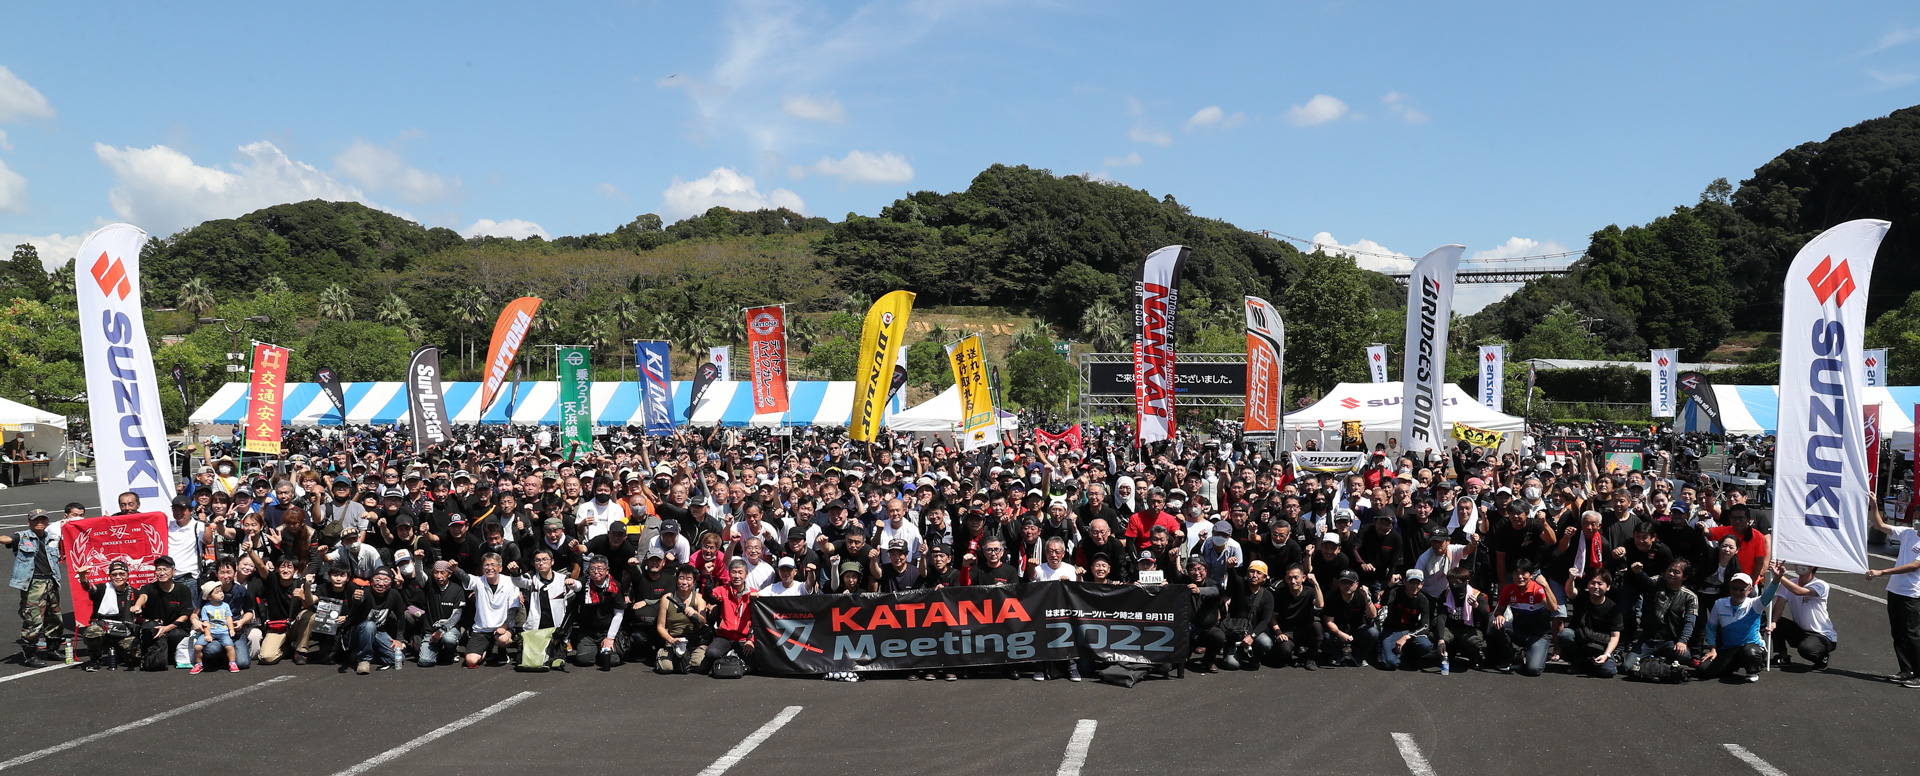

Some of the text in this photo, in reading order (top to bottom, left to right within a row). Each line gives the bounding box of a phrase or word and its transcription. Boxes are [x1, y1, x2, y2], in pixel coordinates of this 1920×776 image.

[1135, 281, 1143, 297] FOR
[1166, 288, 1178, 339] MOTORCYCLE
[750, 320, 779, 328] DAYTONA
[1135, 304, 1143, 327] GOOD
[486, 309, 532, 393] DAYTONA
[760, 341, 775, 406] バイクガレージ
[770, 340, 781, 376] デイトナ
[1135, 333, 1143, 389] MOTORCYCLE
[1166, 342, 1174, 357] TOP
[1166, 359, 1174, 391] FASHION
[1412, 275, 1440, 443] BRIDGESTONE
[102, 309, 159, 498] SUZUKI
[255, 370, 277, 438] 交通安全
[417, 364, 445, 443] SurLuster
[575, 368, 589, 416] 乗ろうよ
[641, 347, 670, 424] KIJIMA
[862, 330, 888, 436] DUNLOP
[955, 352, 973, 411] 受け取れる
[564, 401, 578, 438] 天浜線
[1804, 317, 1845, 530] SUZUKI
[831, 597, 1032, 632] KATANA
[1045, 609, 1174, 621] はままつフルーツパーク時之栖 9月11日
[833, 622, 1174, 661] Meeting 2022
